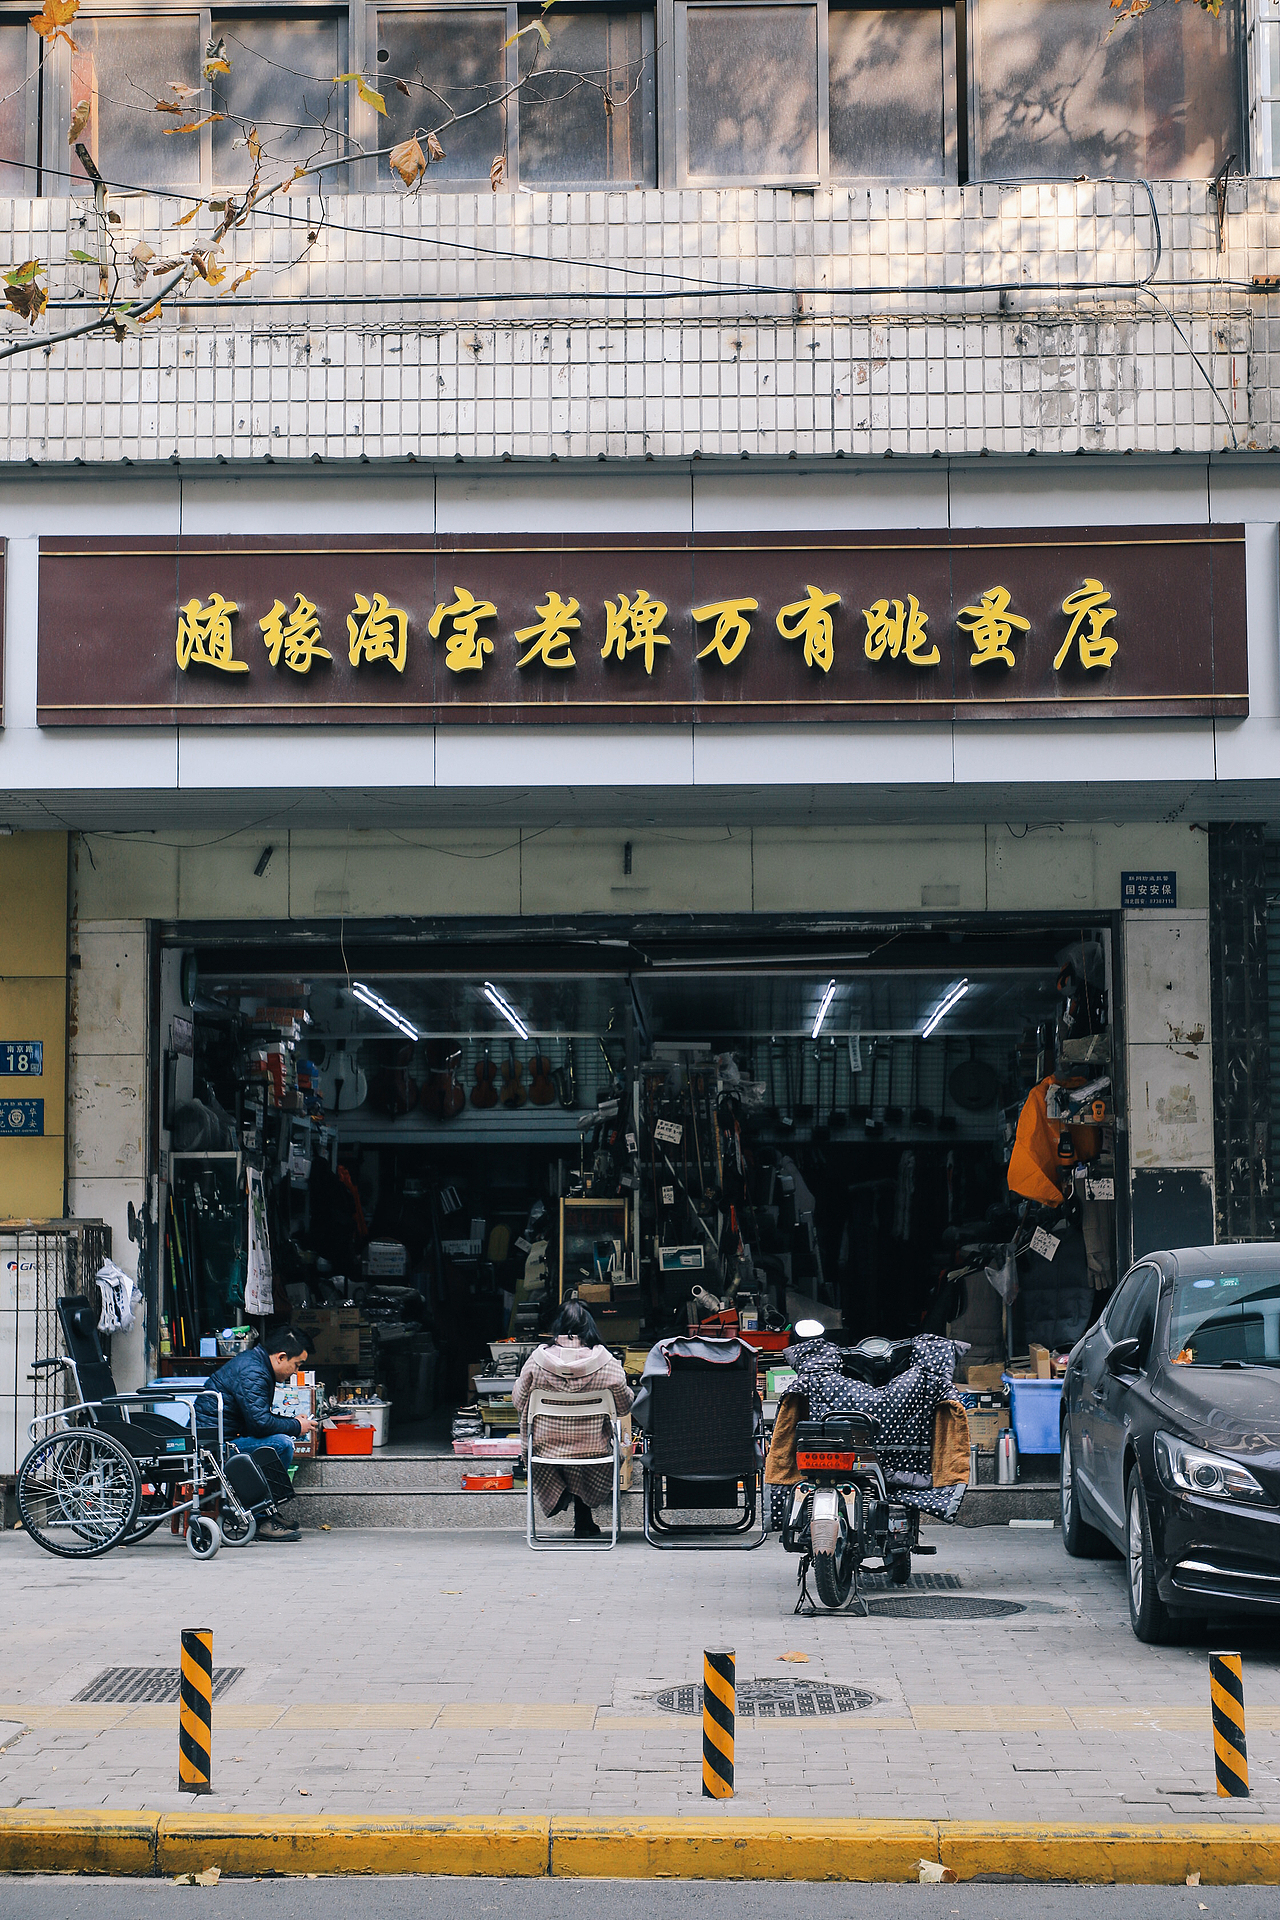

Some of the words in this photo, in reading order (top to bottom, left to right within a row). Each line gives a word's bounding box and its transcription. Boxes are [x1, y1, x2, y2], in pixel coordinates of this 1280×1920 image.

[176, 578, 1119, 674] 随缘淘宝老牌万有跳蚤店
[1126, 884, 1171, 895] 国安安保
[6, 1045, 33, 1053] 南京路
[6, 1054, 28, 1071] 18
